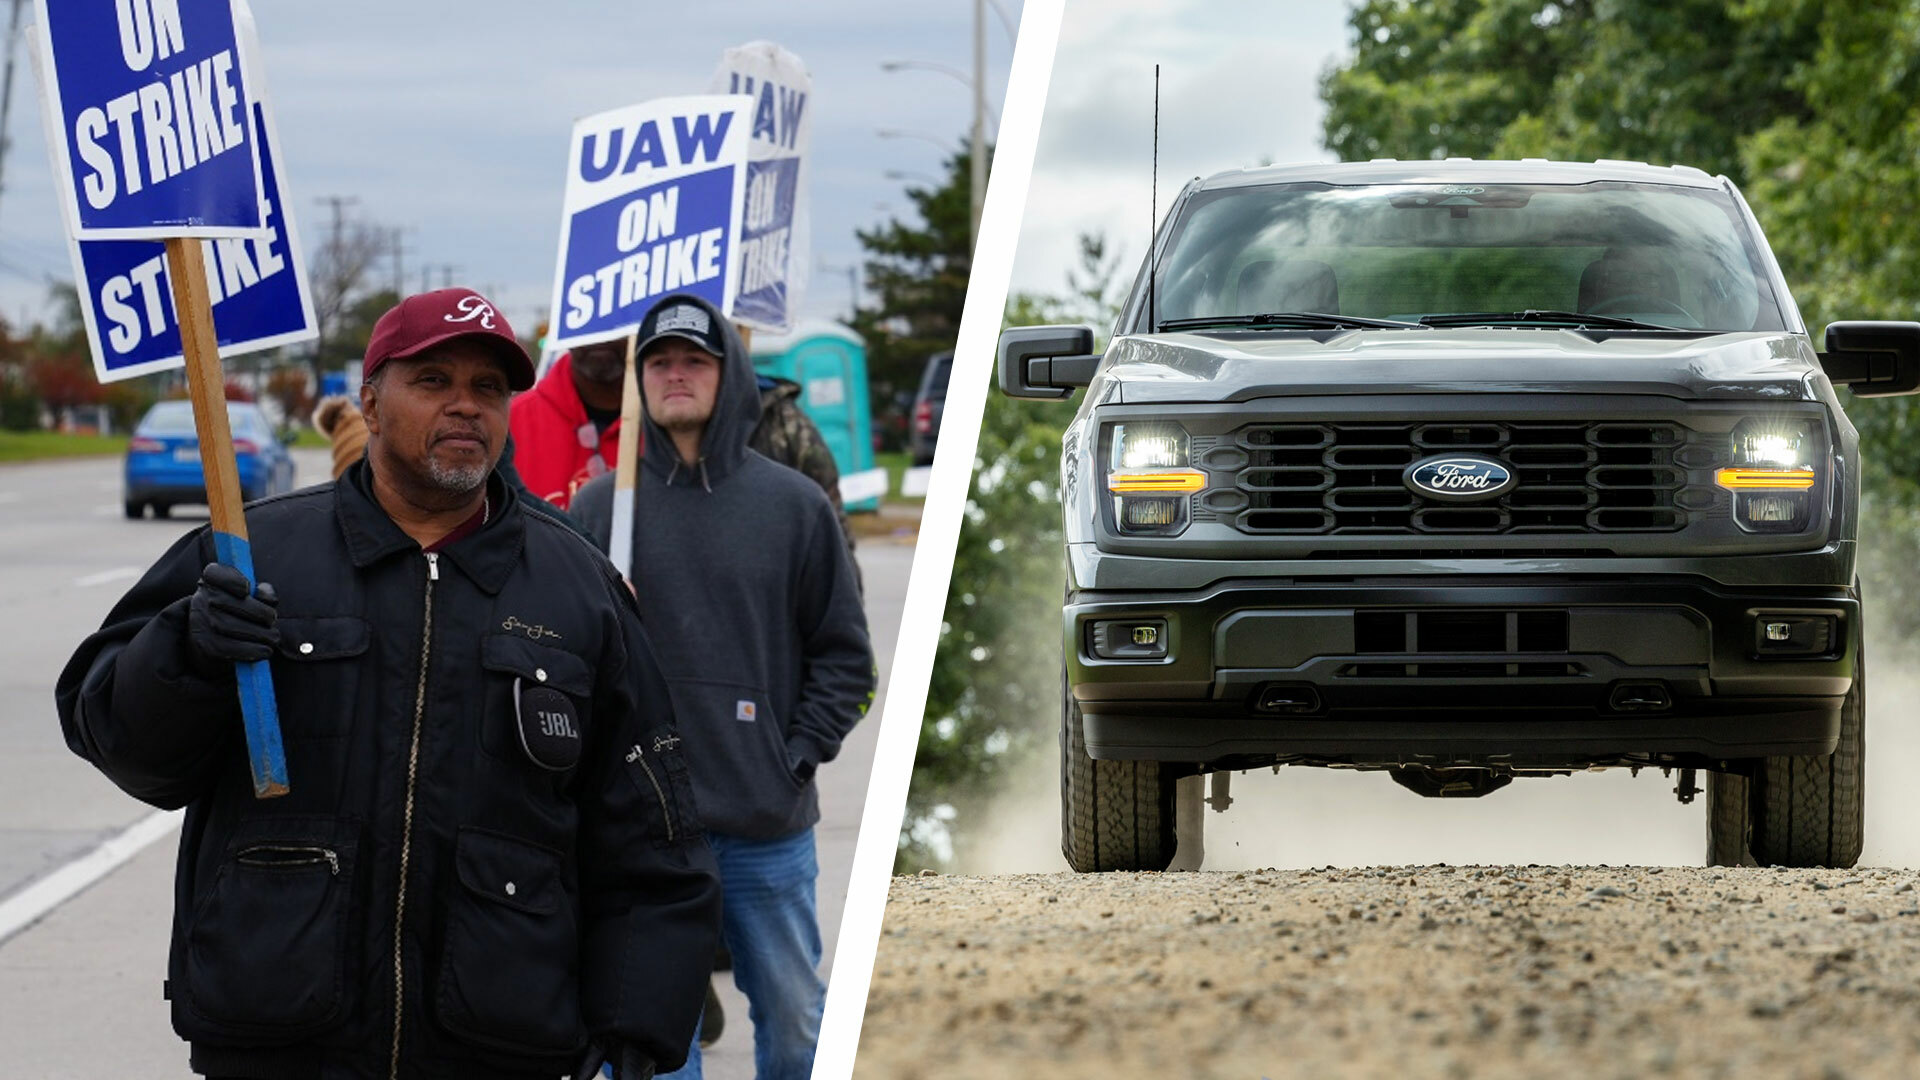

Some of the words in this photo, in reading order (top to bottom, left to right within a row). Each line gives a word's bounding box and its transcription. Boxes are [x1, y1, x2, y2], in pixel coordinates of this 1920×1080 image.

[75, 49, 244, 210] STRIKE
[579, 111, 735, 183] UAW
[616, 185, 680, 253] ON
[100, 199, 285, 355] STIKE
[565, 227, 723, 331] STRIKE
[1431, 463, 1491, 489] Ford
[538, 711, 578, 739] JBL
